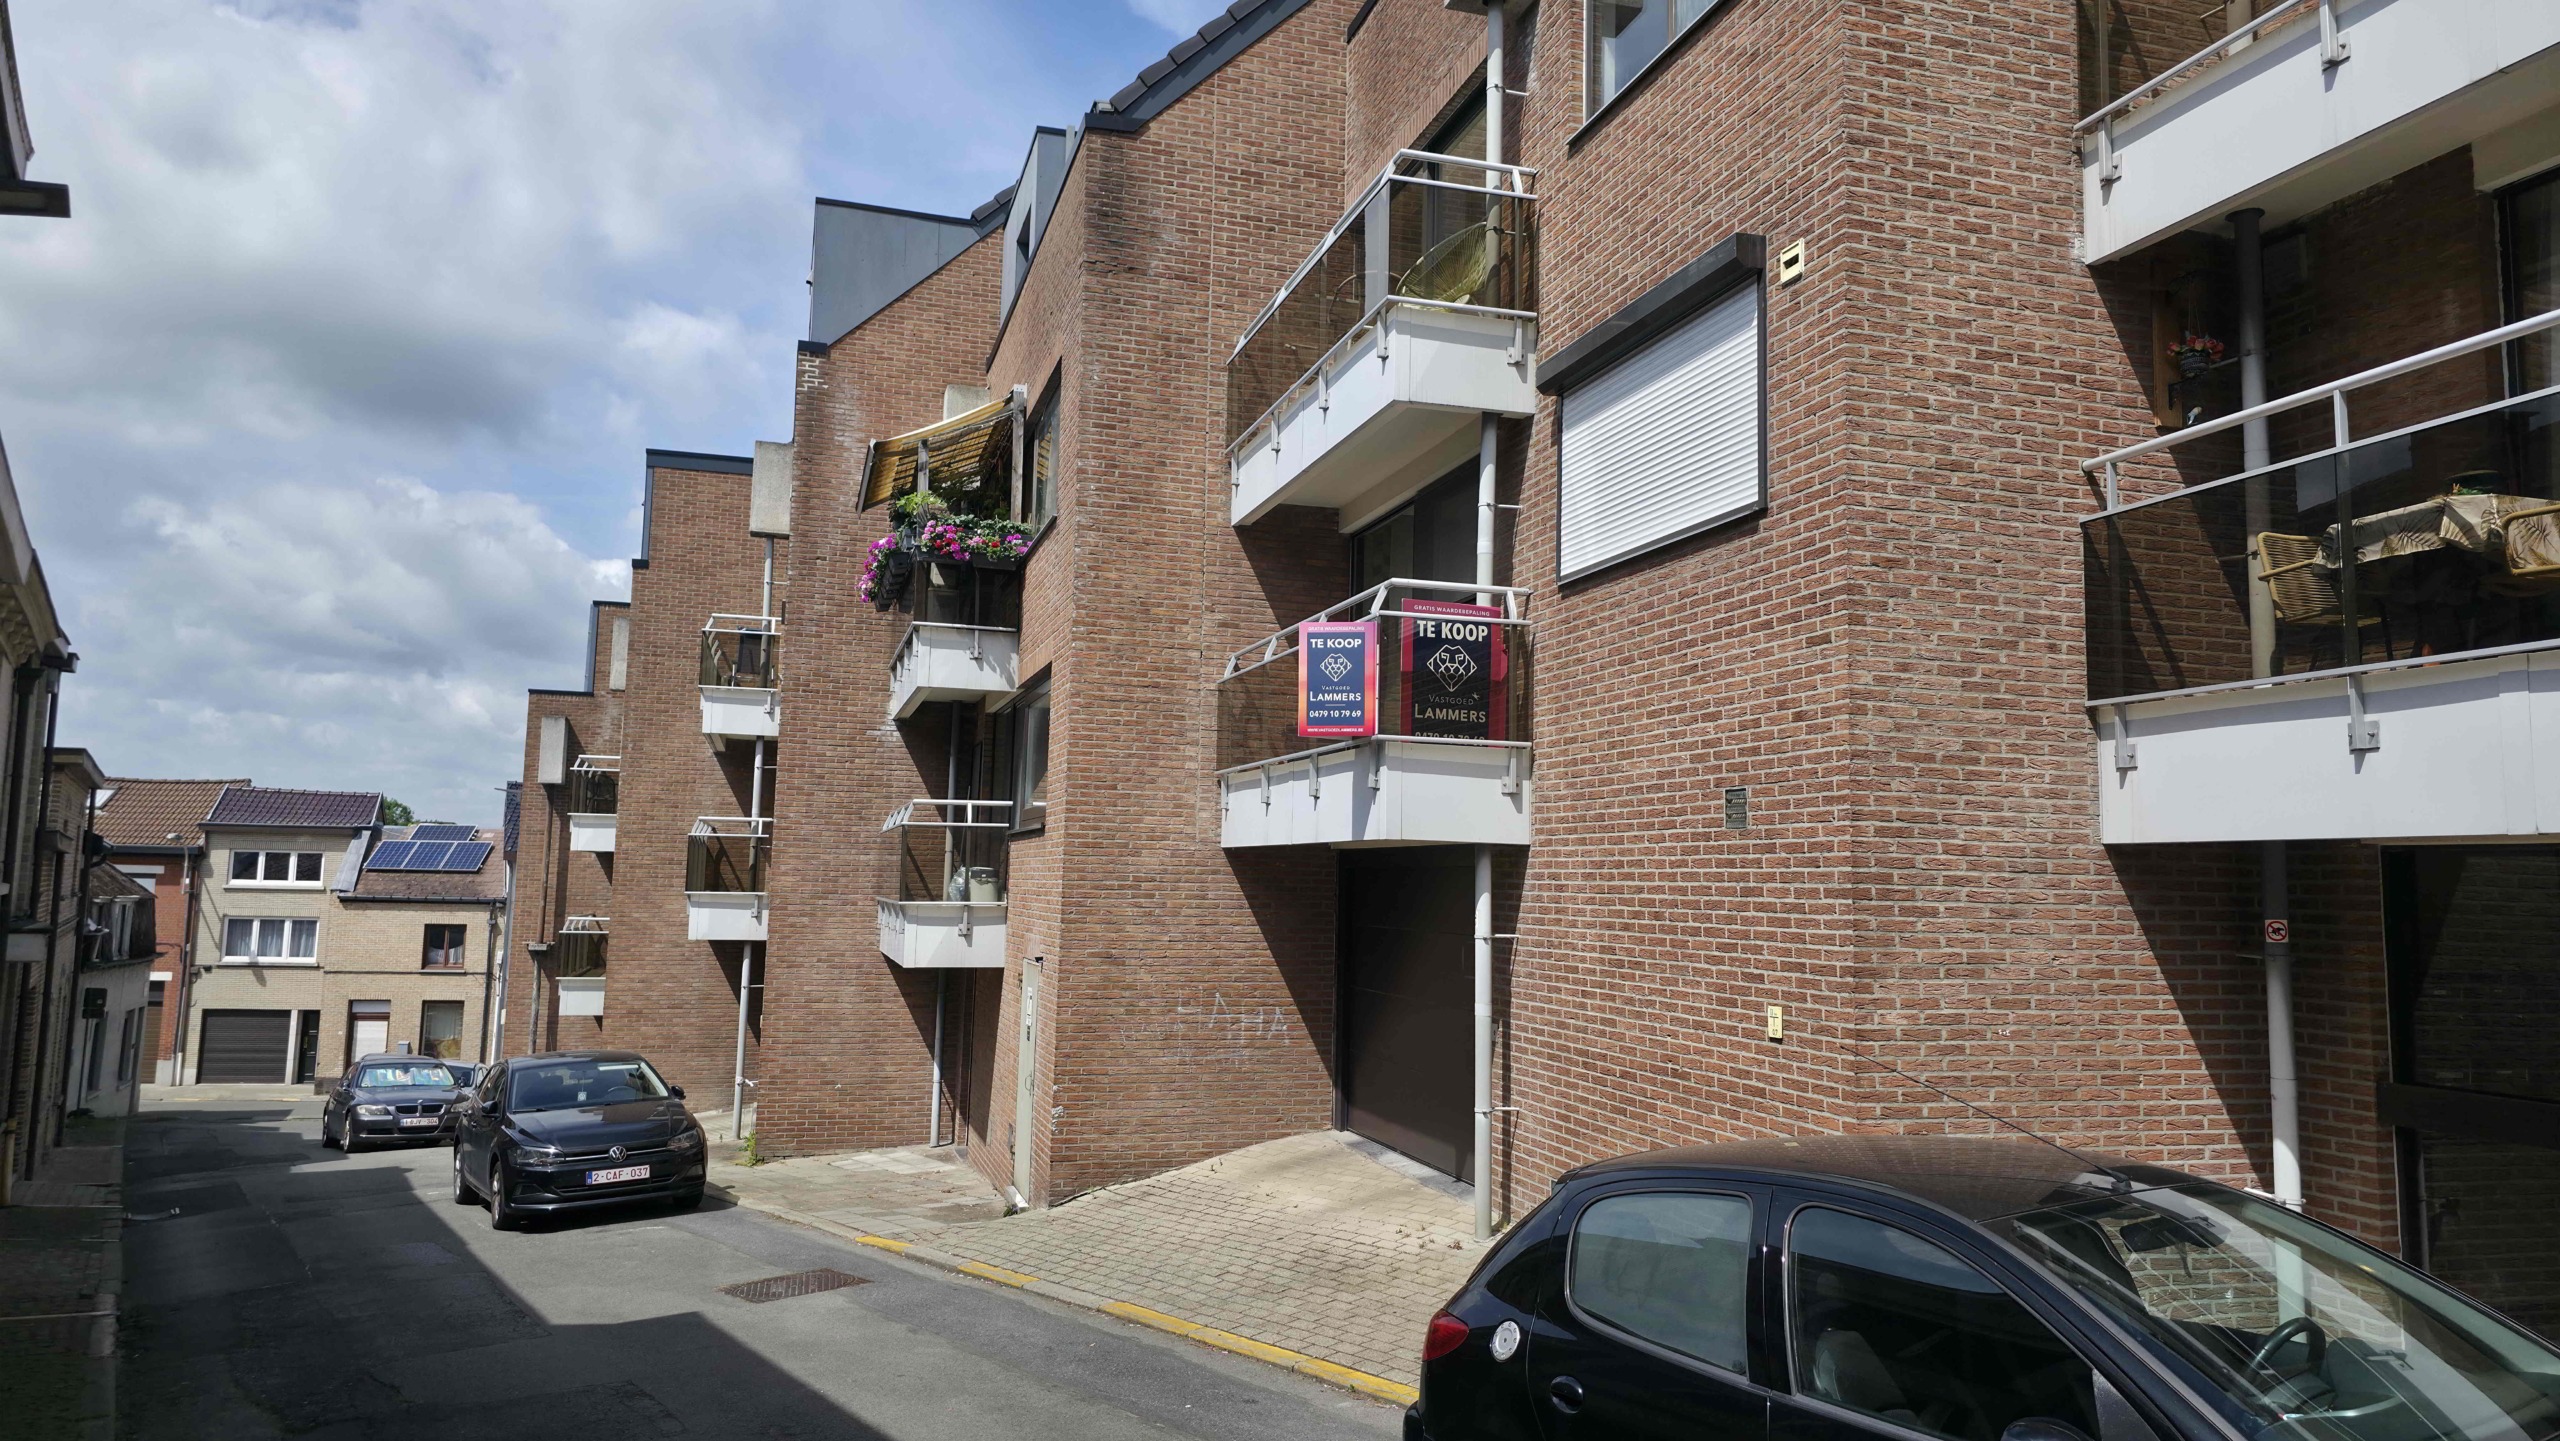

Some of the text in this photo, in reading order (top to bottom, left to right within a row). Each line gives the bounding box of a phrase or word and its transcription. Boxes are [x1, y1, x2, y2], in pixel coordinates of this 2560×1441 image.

[1437, 606, 1490, 617] WAARDEBEPALING
[1417, 620, 1488, 642] TE KOOP
[1310, 638, 1362, 648] TE KOOP
[1310, 691, 1361, 701] LAMMERS
[1428, 694, 1474, 705] VASTGOED
[1414, 703, 1486, 723] LAMMERS
